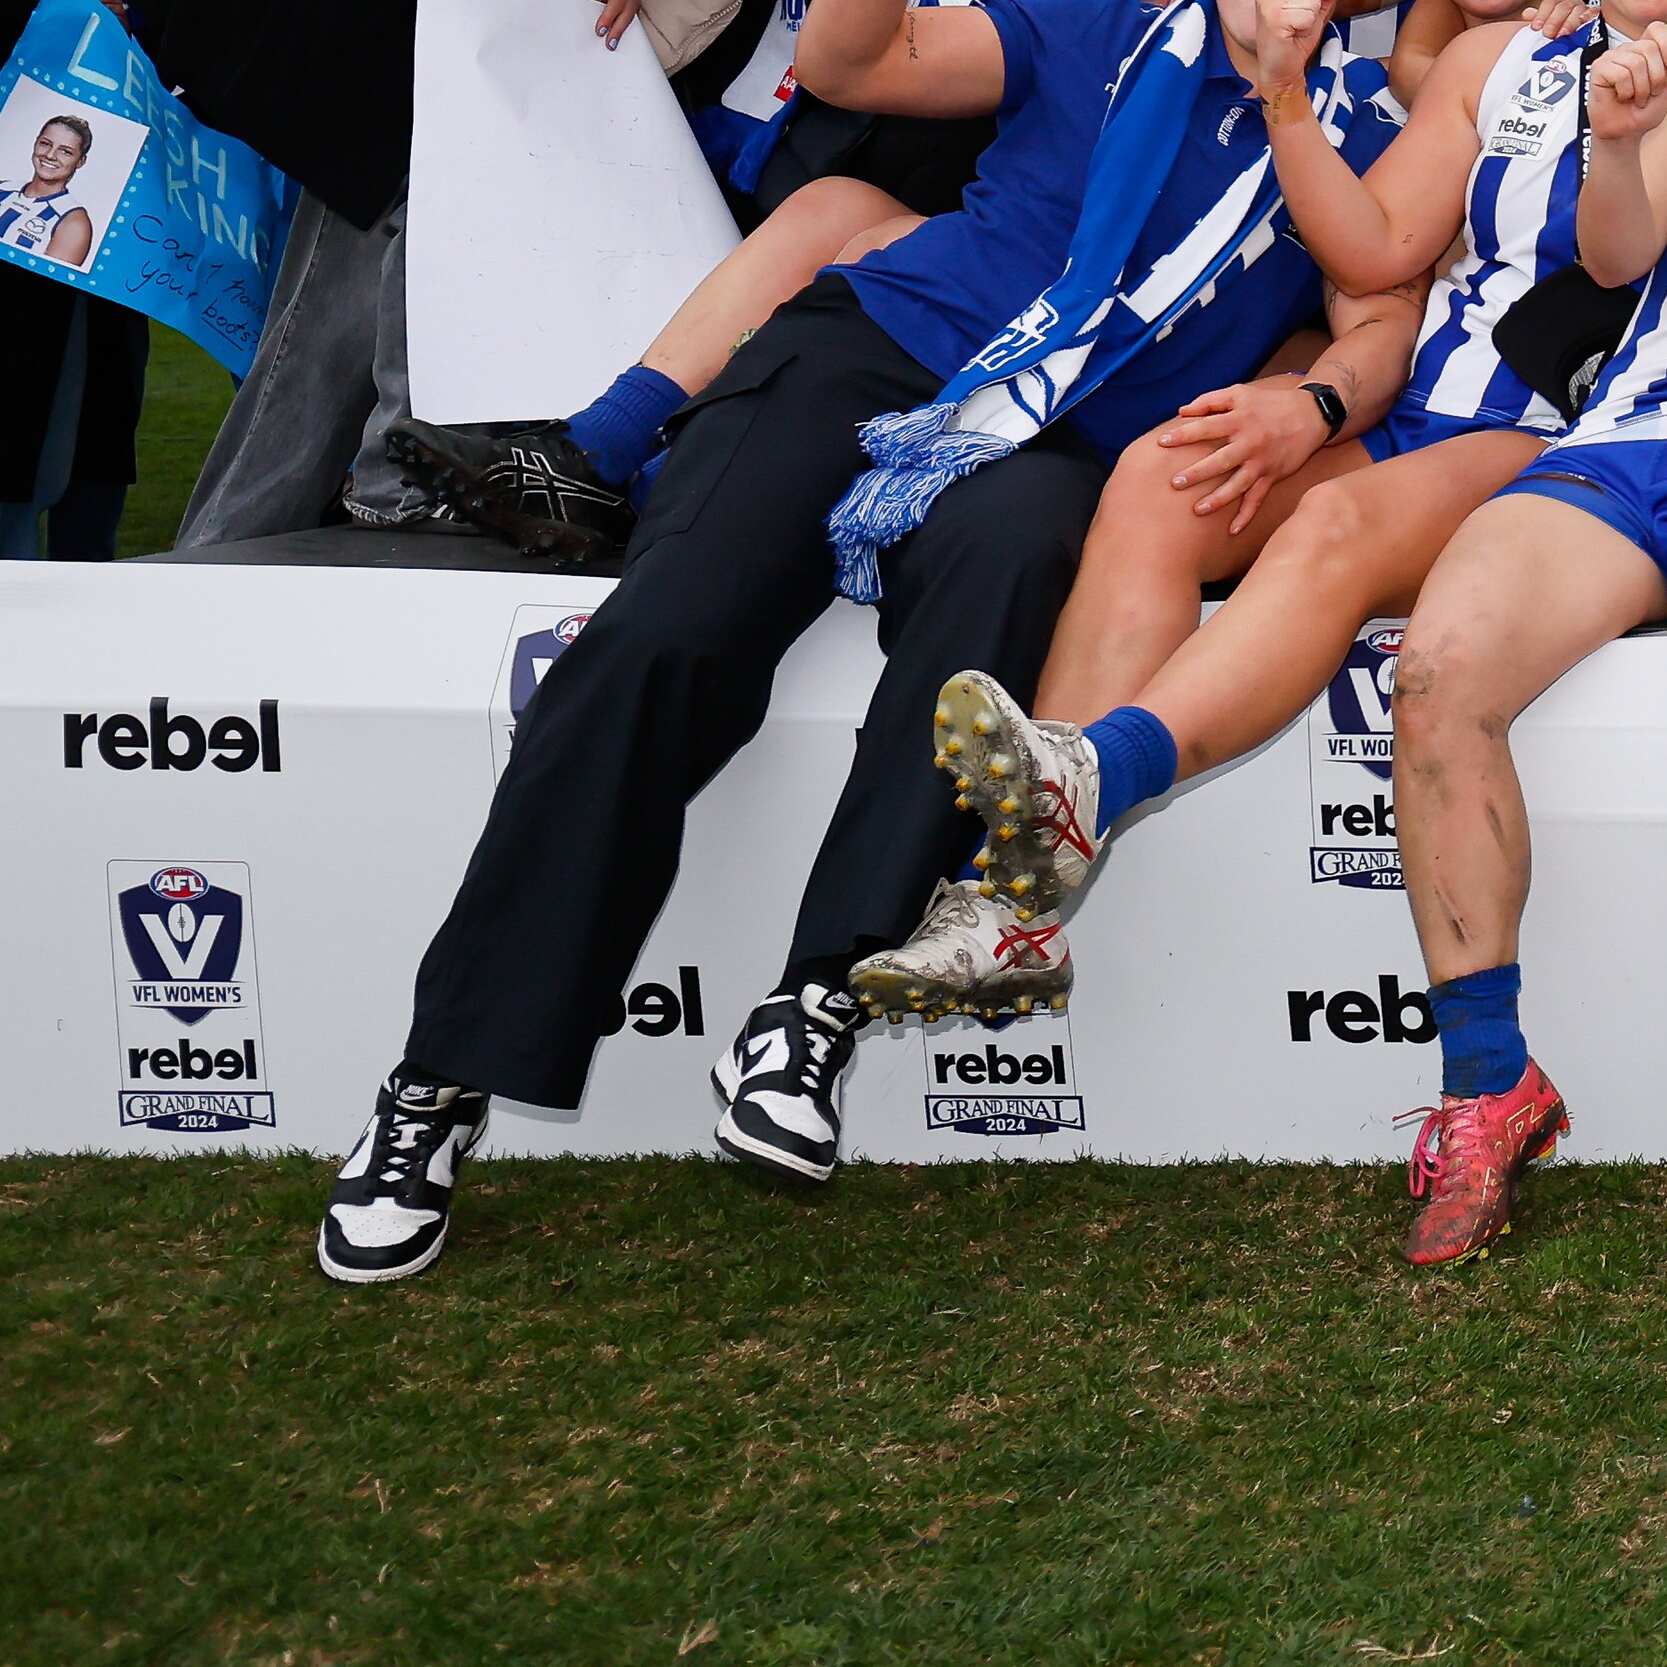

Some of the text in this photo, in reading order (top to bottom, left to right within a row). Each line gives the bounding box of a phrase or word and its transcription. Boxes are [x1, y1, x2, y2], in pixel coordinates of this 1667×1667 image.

[1499, 117, 1547, 139] rebel
[125, 260, 198, 293] your
[63, 697, 282, 773] rebel
[1328, 739, 1361, 756] VFL
[1320, 795, 1397, 836] reb
[1317, 850, 1388, 873] GRAND
[156, 875, 204, 893] AFL
[133, 986, 242, 1003] VFL WOMEN'S
[835, 991, 855, 1006] NIKE
[1288, 975, 1442, 1044] reb
[128, 1039, 257, 1080] rebel
[934, 1044, 1066, 1084] rebel
[126, 1095, 269, 1117] GRAND FINAL
[932, 1098, 1078, 1123] GRAND FINAL
[178, 1115, 218, 1128] 2024
[986, 1118, 1026, 1132] 2024
